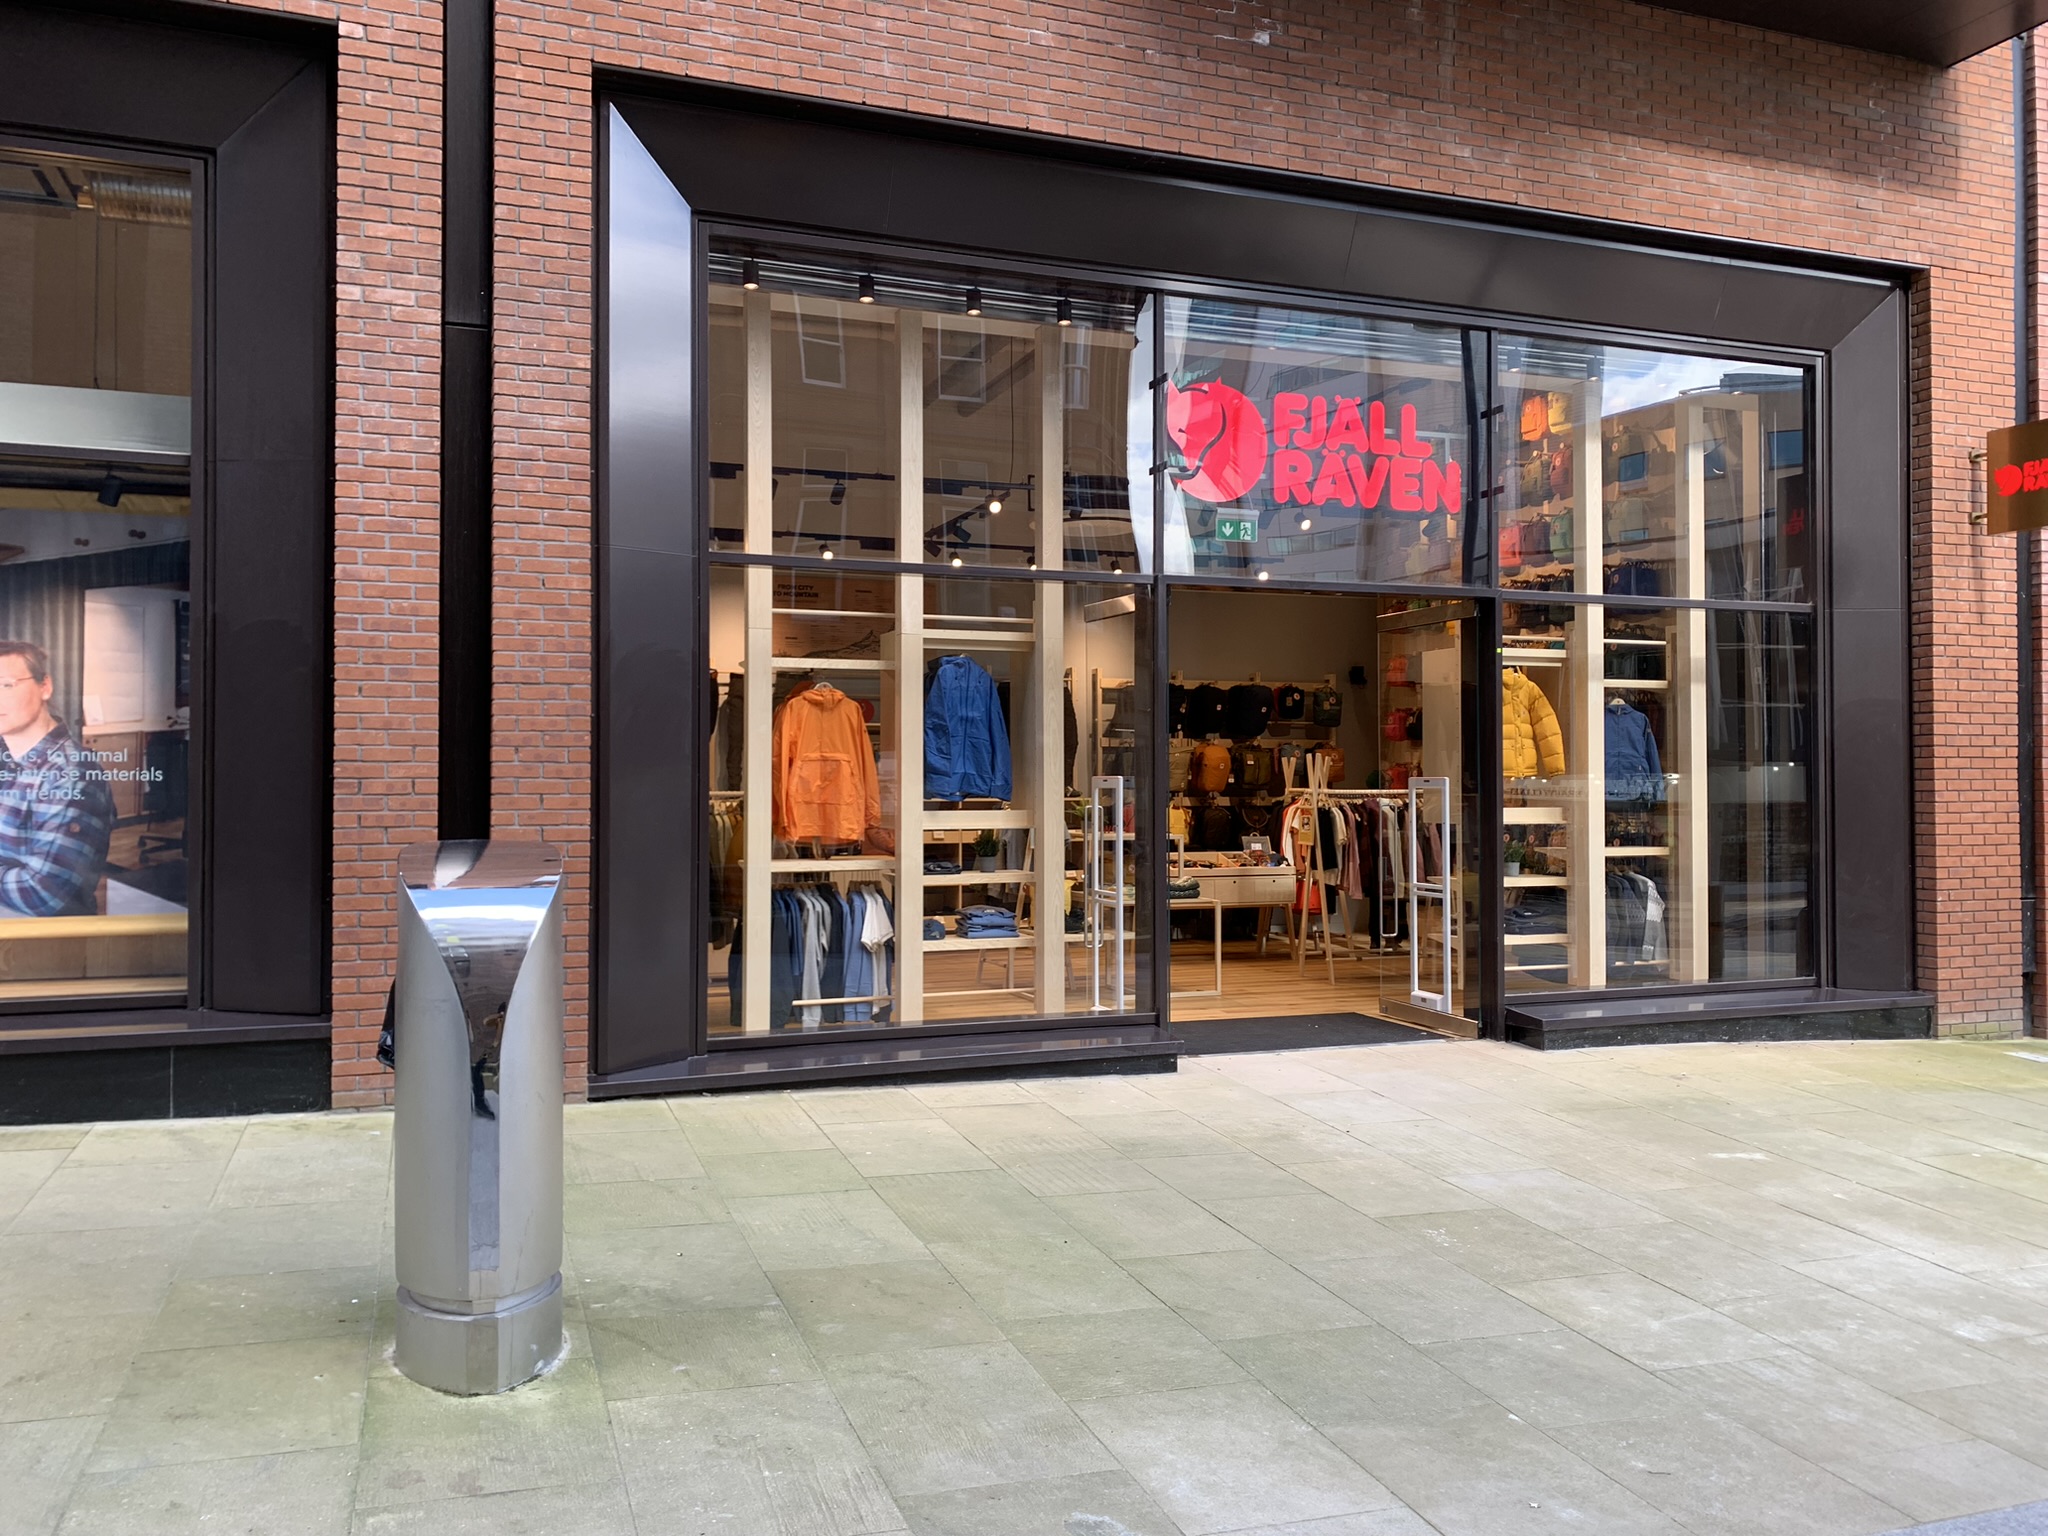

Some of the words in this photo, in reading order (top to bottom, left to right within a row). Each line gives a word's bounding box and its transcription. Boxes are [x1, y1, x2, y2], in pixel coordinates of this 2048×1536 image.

[1273, 392, 1433, 459] FJÄLL
[1273, 448, 1462, 514] RÄVEN
[47, 748, 63, 762] to
[69, 748, 128, 763] animal
[85, 767, 164, 782] materials
[26, 785, 85, 801] trends.
